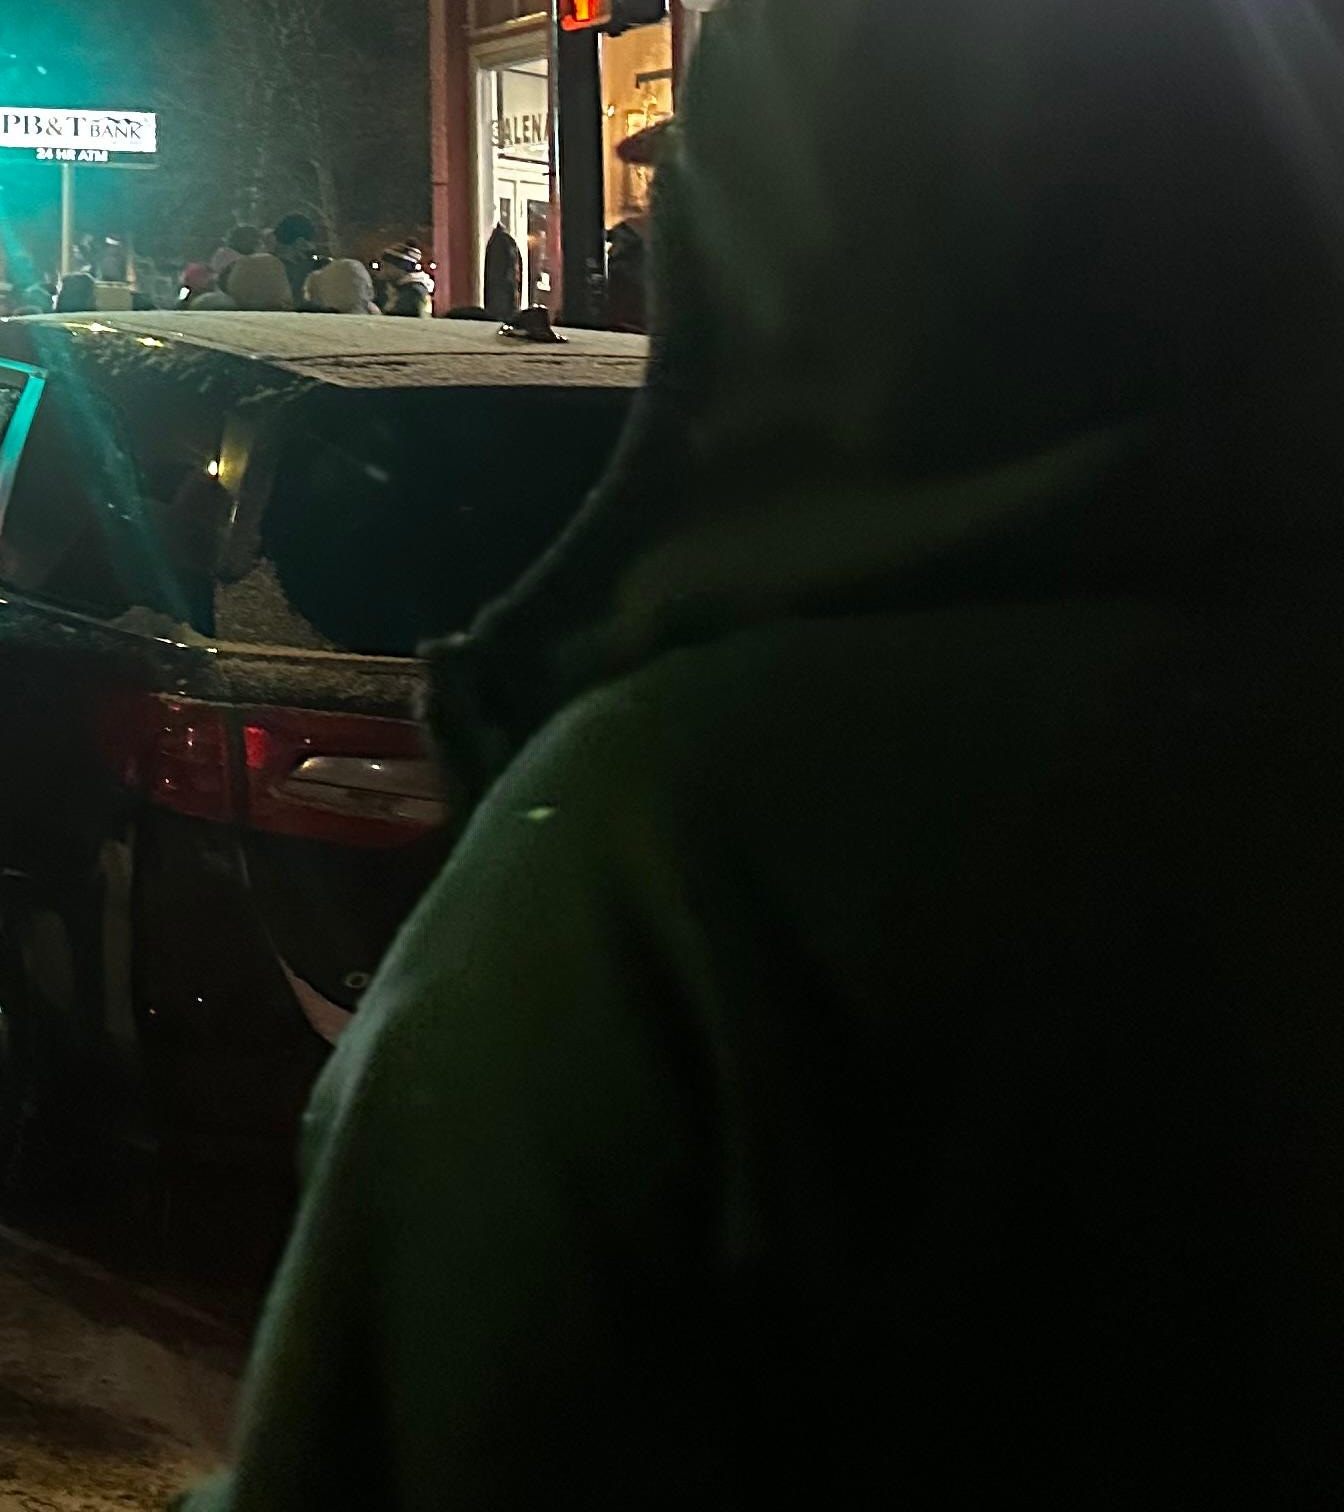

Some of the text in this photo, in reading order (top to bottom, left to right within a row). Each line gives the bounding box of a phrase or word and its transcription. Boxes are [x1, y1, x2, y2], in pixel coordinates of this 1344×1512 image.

[2, 114, 142, 139] PB&T BANK
[491, 113, 548, 146] ALEN
[78, 149, 109, 162] ATM
